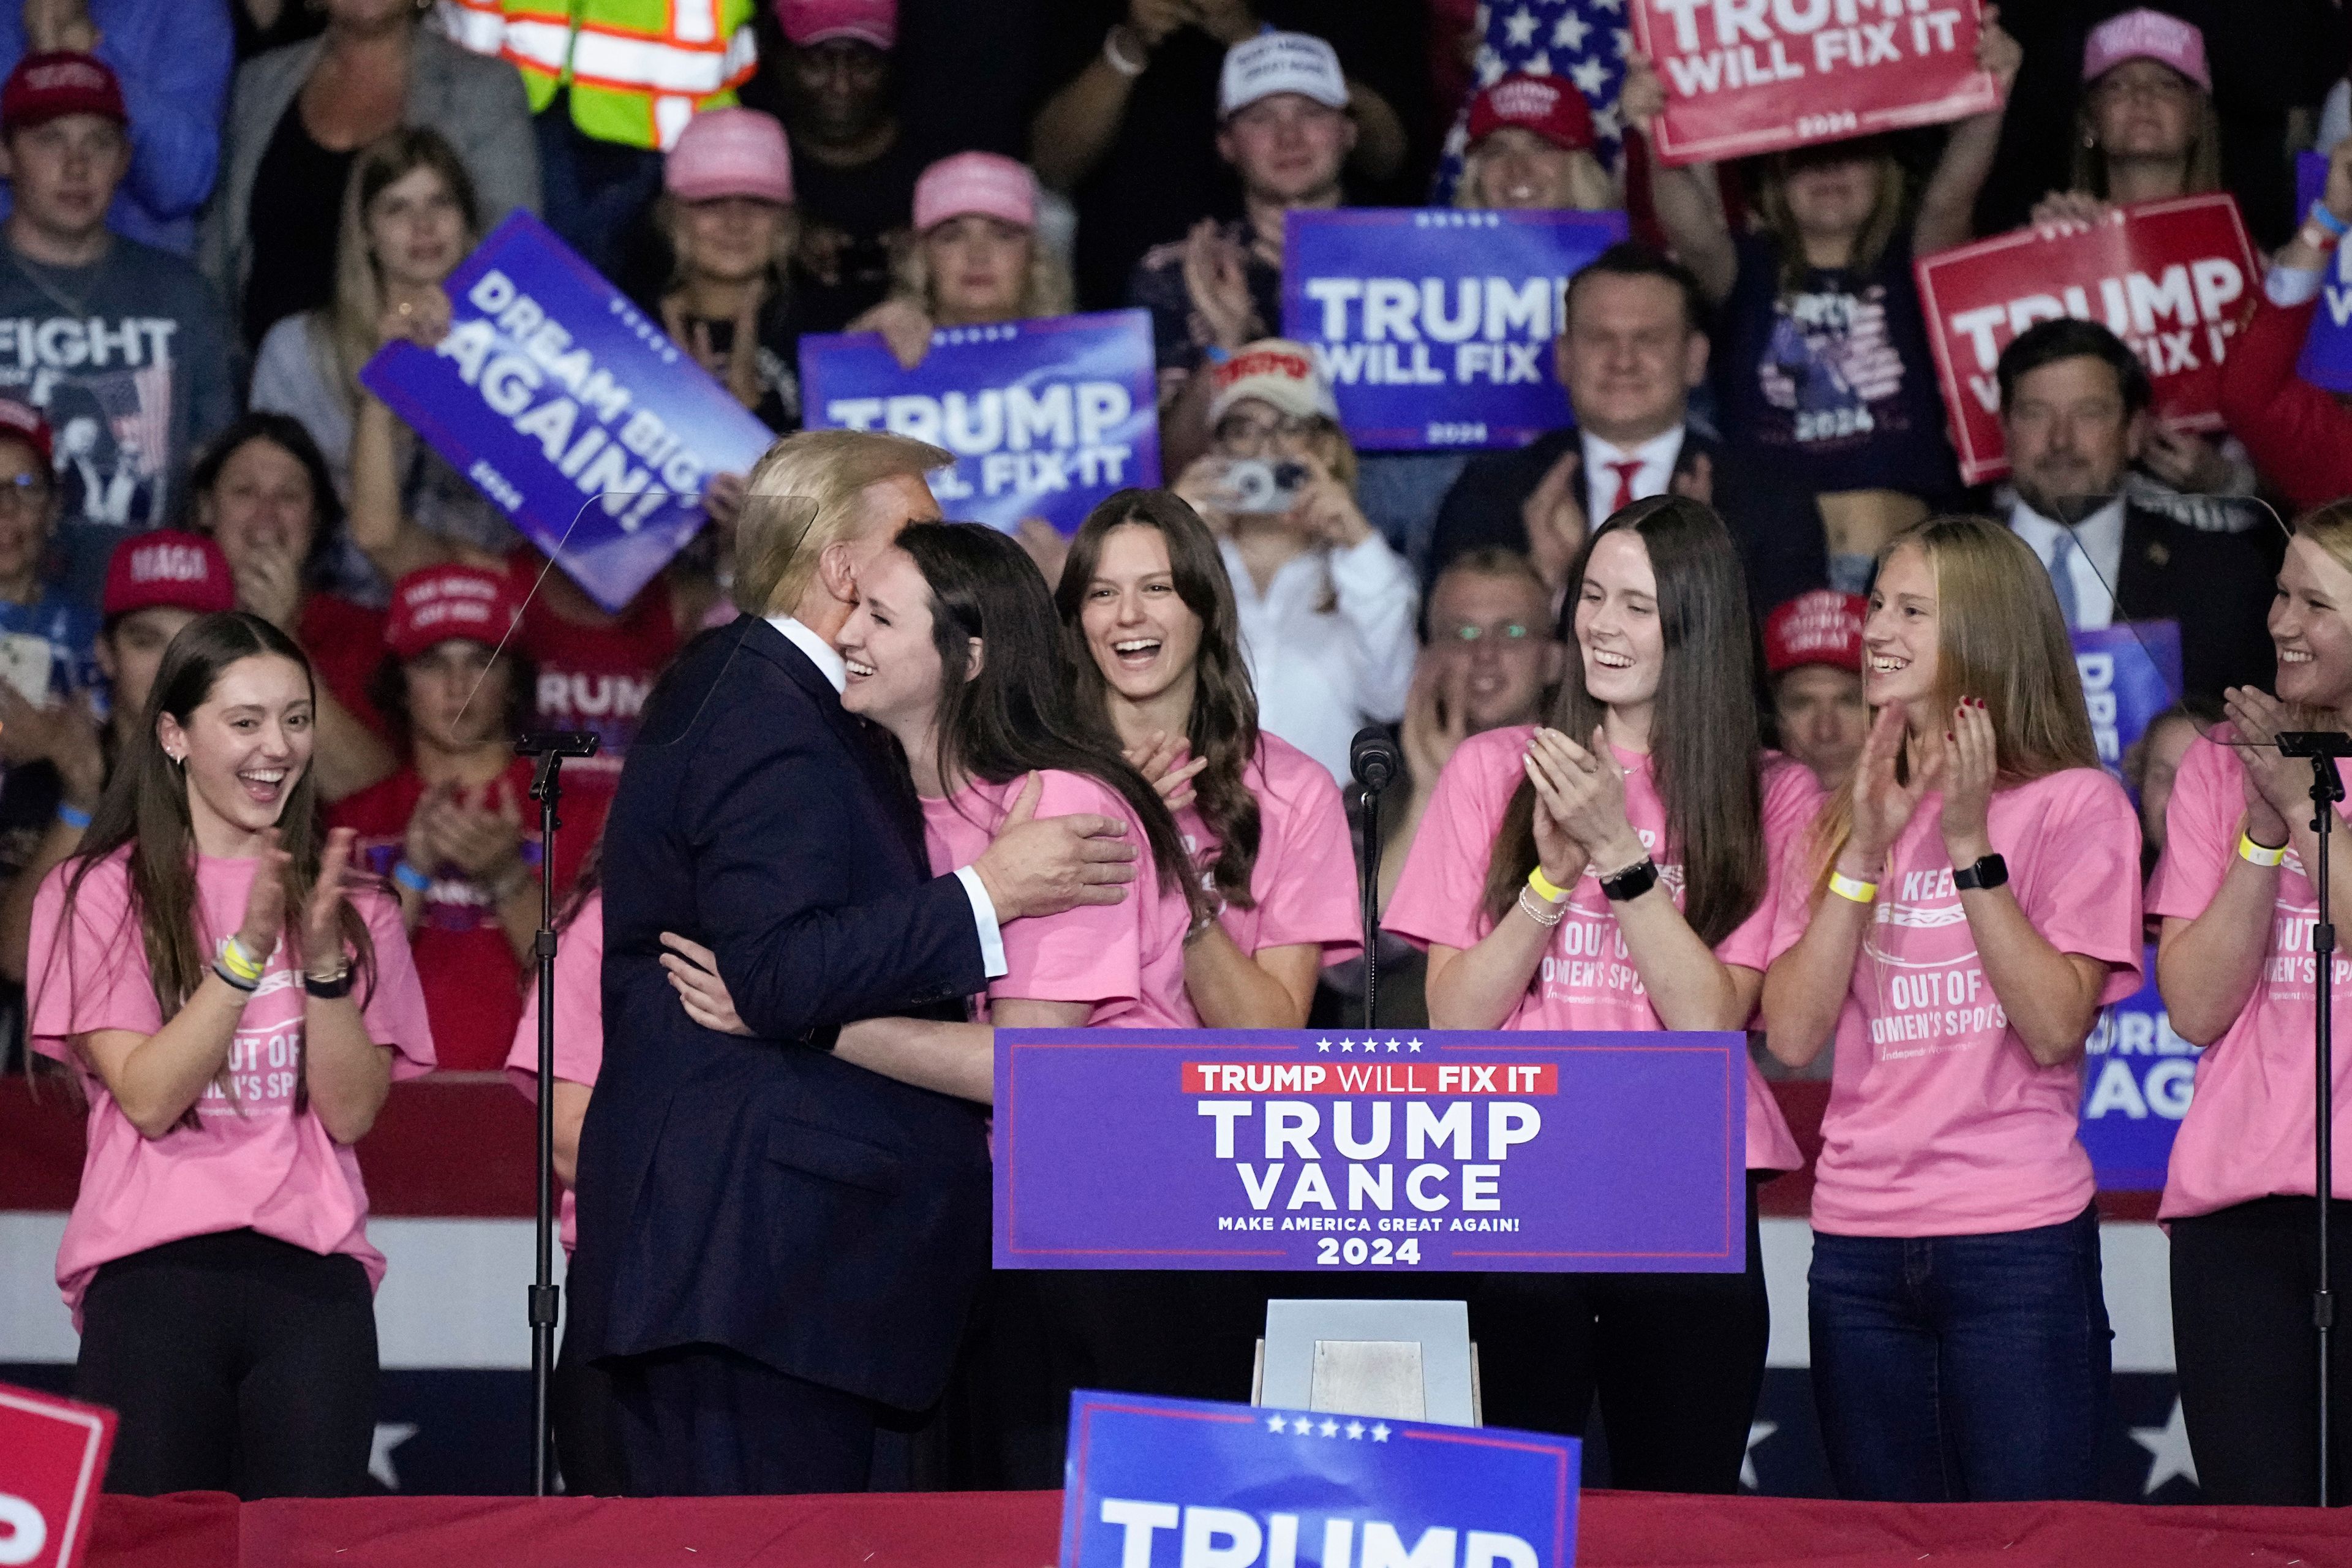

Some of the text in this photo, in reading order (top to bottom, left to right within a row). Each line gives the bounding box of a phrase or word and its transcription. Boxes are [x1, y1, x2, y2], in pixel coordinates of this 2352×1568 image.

[1666, 9, 1961, 97] WILL FIX IT
[1305, 276, 1567, 342] TRUM
[1314, 341, 1446, 386] WILL
[1455, 342, 1542, 385] FIX
[468, 269, 706, 508] DREAM BIG
[436, 317, 668, 532] AGAIN!
[1794, 406, 1875, 442] 2024
[982, 451, 1069, 496] FIX
[1079, 445, 1132, 487] IT
[1542, 956, 1605, 989] OMEN'S
[1891, 968, 1983, 1011] OUT OF
[1871, 1012, 1942, 1044] OMEN'S
[1198, 1065, 1541, 1092] TRUMP WILL FIX IT
[1197, 1100, 1541, 1160] TRUMP
[1235, 1163, 1501, 1212] VANCE
[1218, 1217, 1520, 1232] MAKE AMERICA GREAT AGAIN!
[1317, 1237, 1421, 1265] 2024
